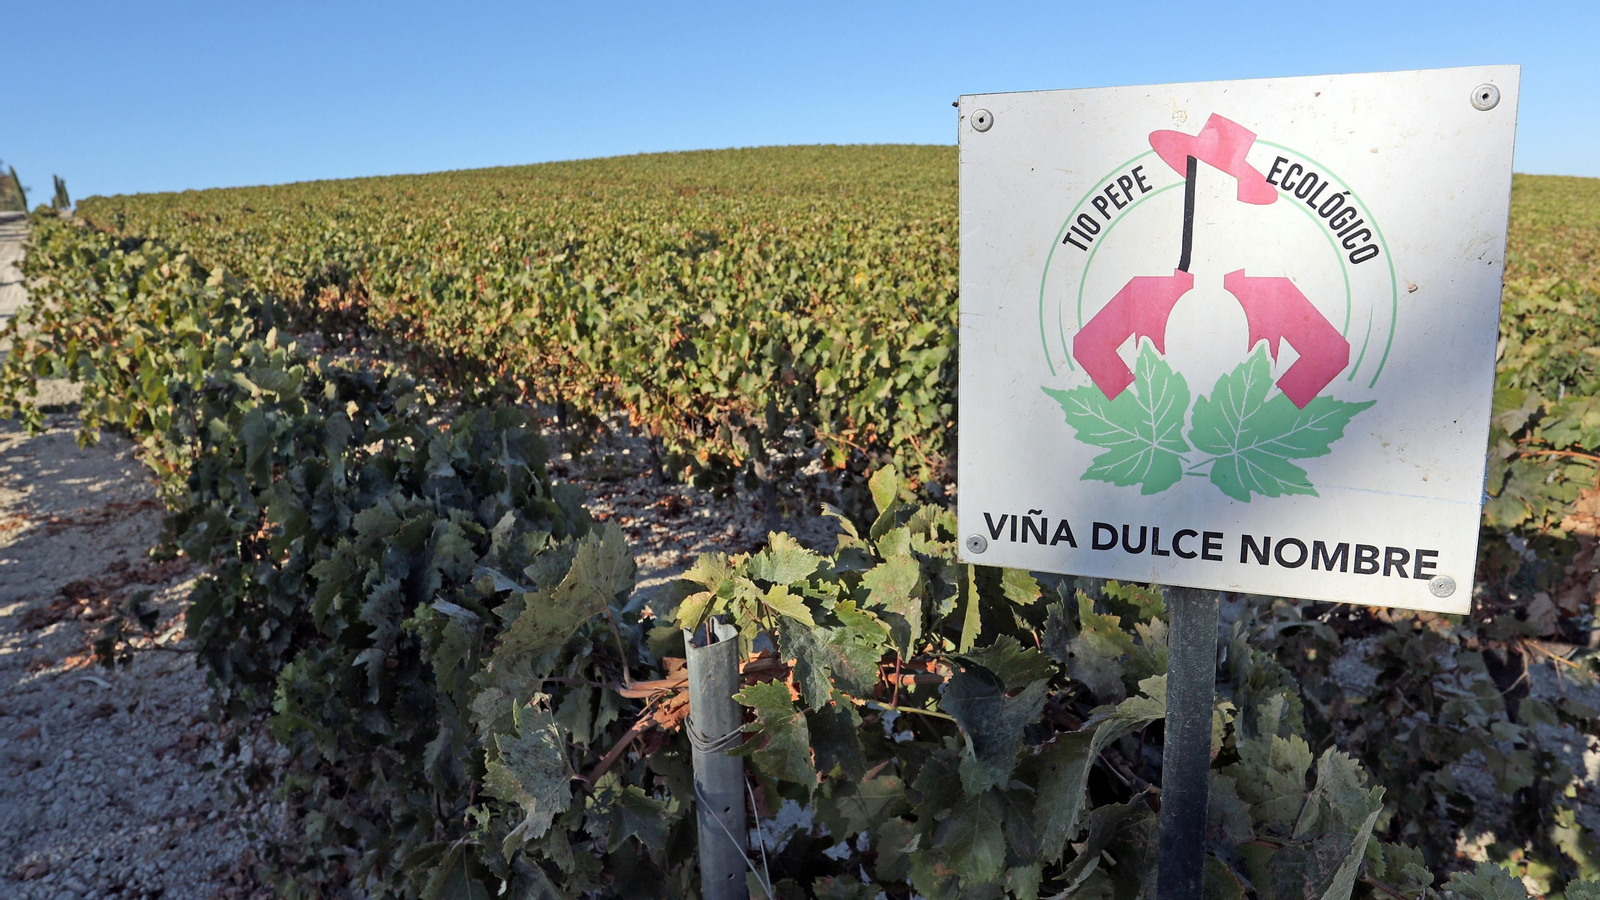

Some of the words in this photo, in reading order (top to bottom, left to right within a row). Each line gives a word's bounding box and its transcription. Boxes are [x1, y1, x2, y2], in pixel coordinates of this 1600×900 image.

[1061, 213, 1101, 252] TIO
[1091, 165, 1153, 221] PEPE
[1265, 155, 1380, 265] ECOLÓGICO
[983, 508, 1079, 549] VIÑA
[1091, 521, 1224, 562] DULCE
[1239, 534, 1439, 581] NOMBRE
